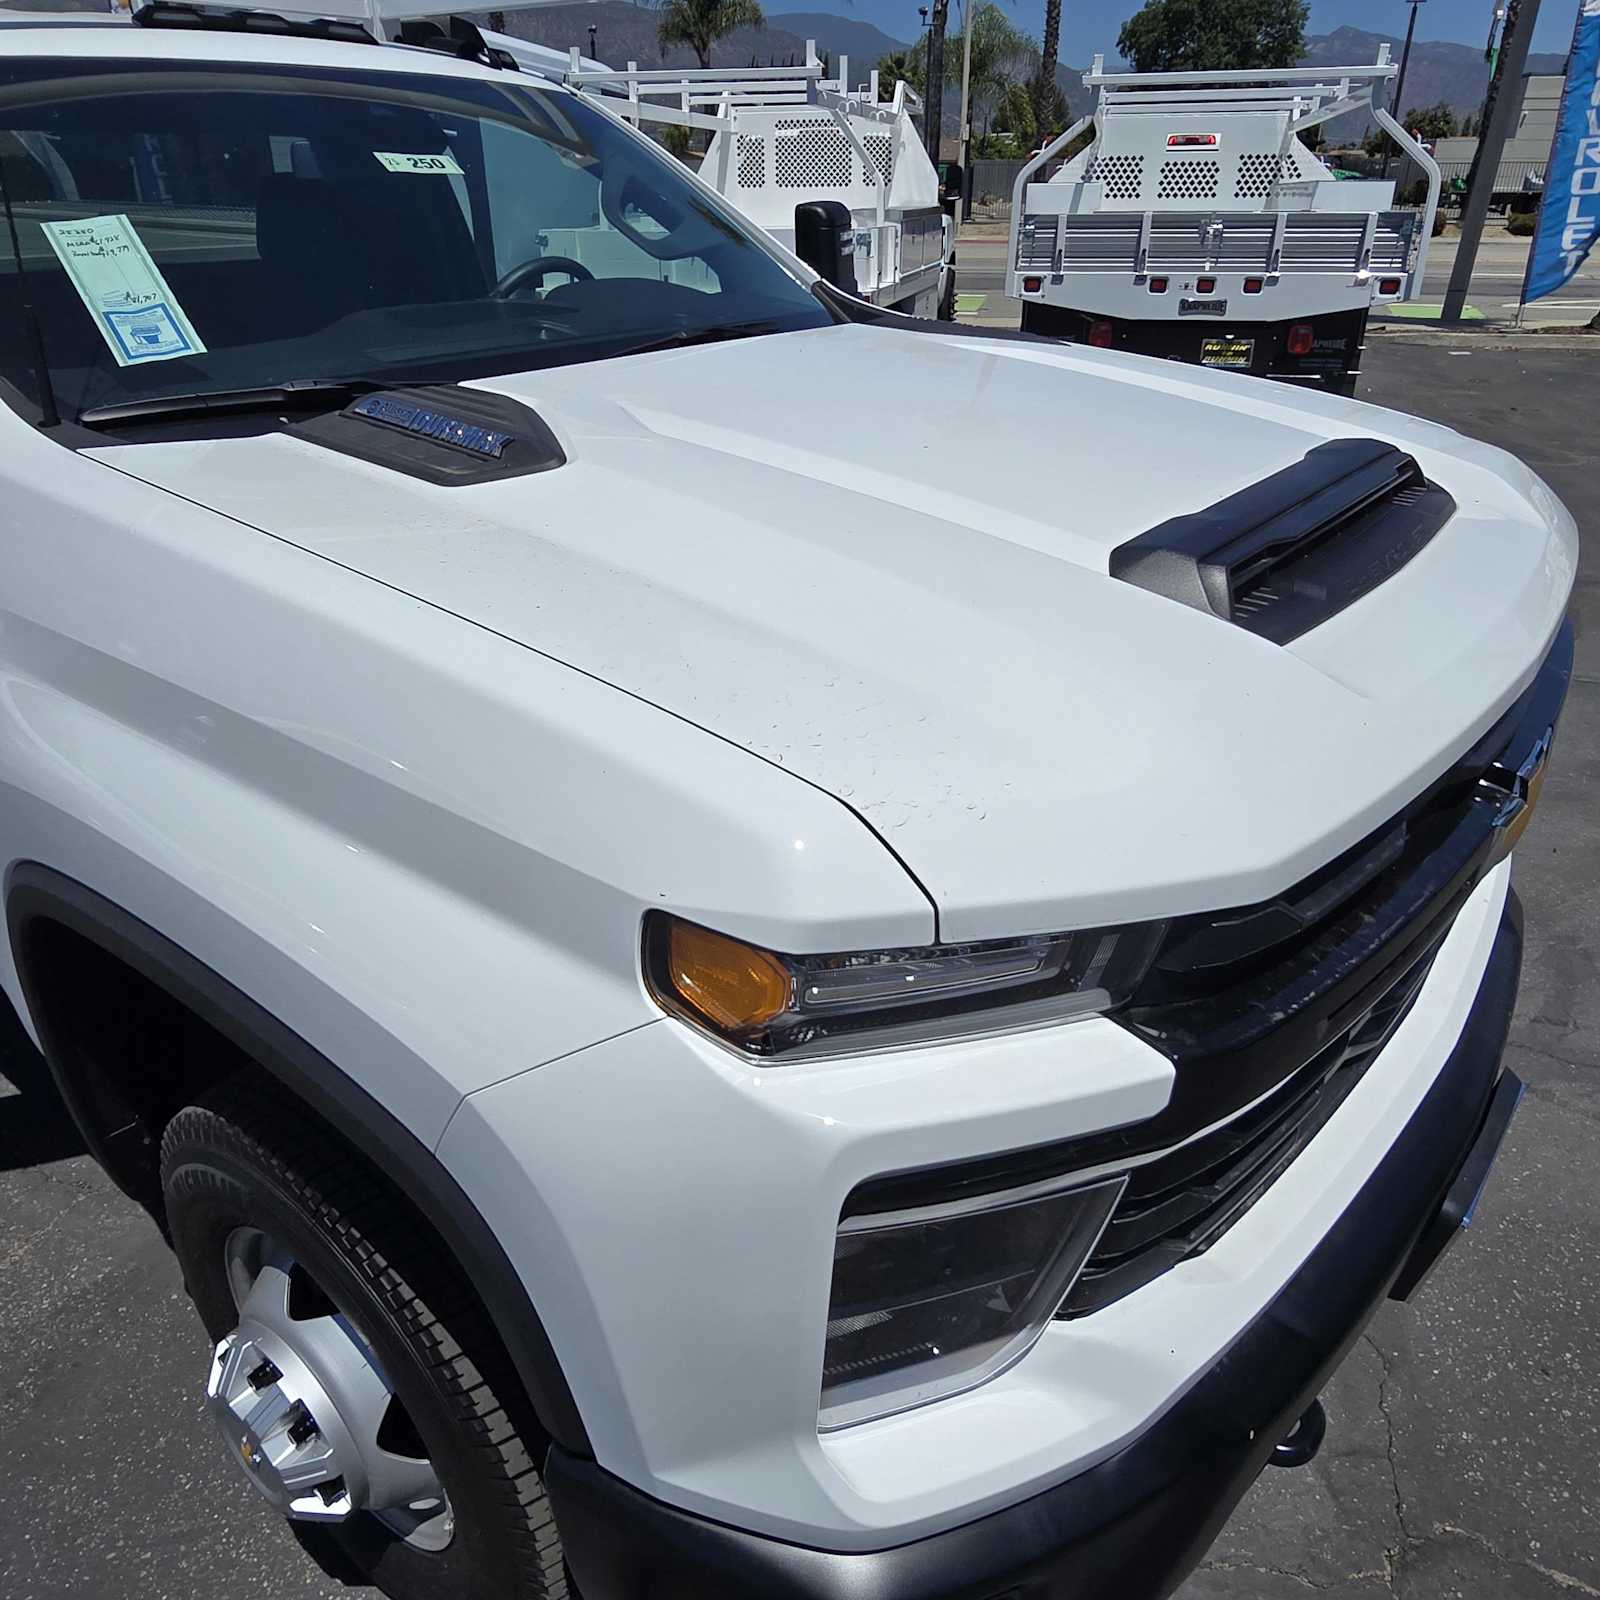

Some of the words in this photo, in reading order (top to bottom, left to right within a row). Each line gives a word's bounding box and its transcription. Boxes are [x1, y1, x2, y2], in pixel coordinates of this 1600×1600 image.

[406, 157, 446, 169] 250
[1560, 78, 1600, 276] ROLET
[409, 408, 514, 458] DURAMAX
